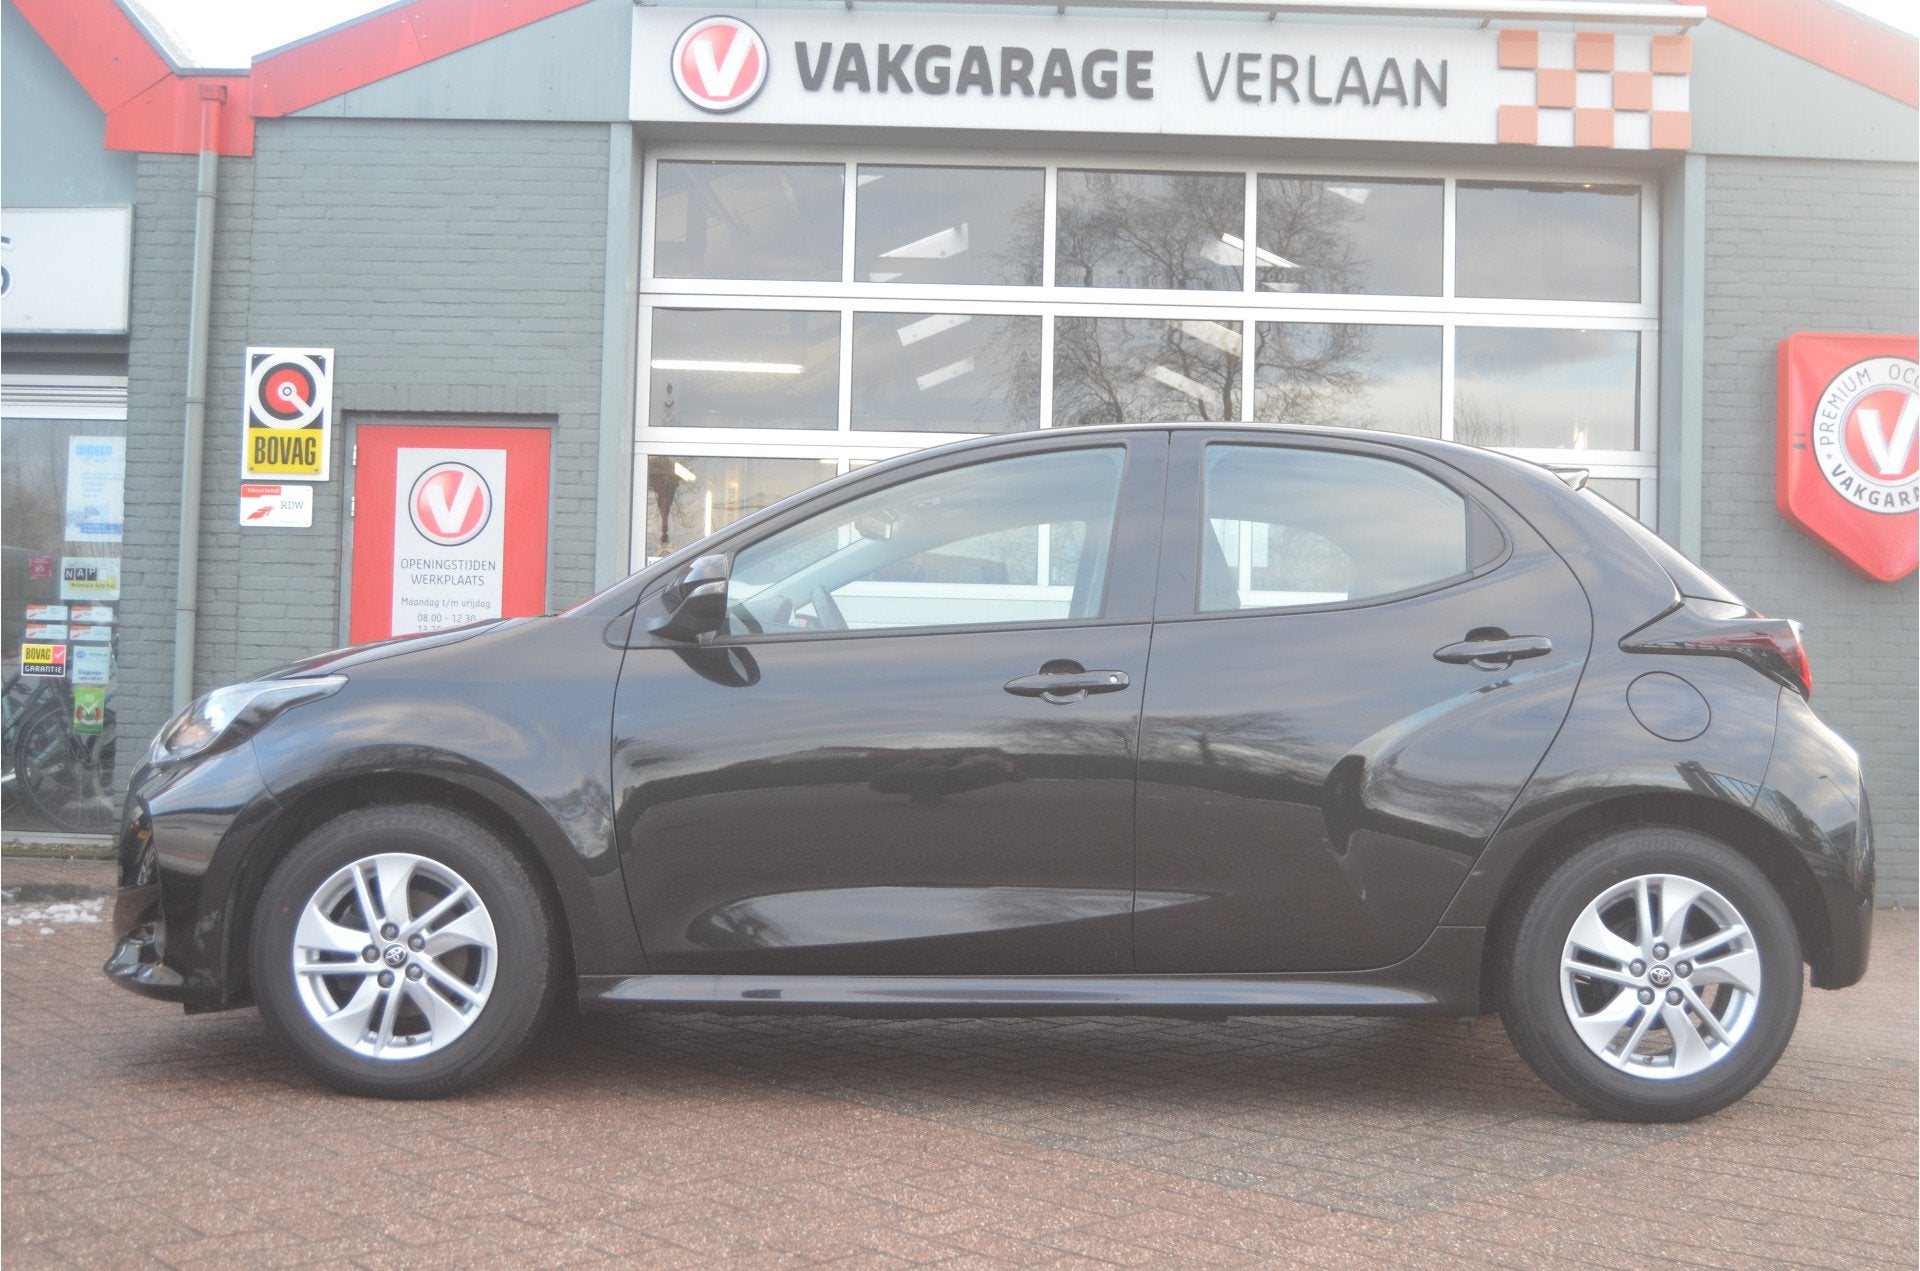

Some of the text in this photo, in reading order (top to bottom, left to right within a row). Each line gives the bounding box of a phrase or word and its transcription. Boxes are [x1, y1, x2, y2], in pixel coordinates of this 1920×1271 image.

[795, 41, 1448, 107] VAKGARAGE VERLAAN
[1819, 367, 1872, 446] PREMIUM
[254, 435, 317, 467] BOVAG
[280, 500, 304, 510] RDW
[400, 558, 496, 571] OPENINGSTIJDEN
[65, 568, 96, 579] NAP
[411, 573, 485, 586] WERKPLAATS
[401, 597, 491, 610] Maandag t/m vrijdag
[417, 613, 443, 623] 08.00
[452, 614, 476, 624] 12.30
[25, 647, 51, 661] BOVAG
[24, 665, 63, 674] GARANTIE
